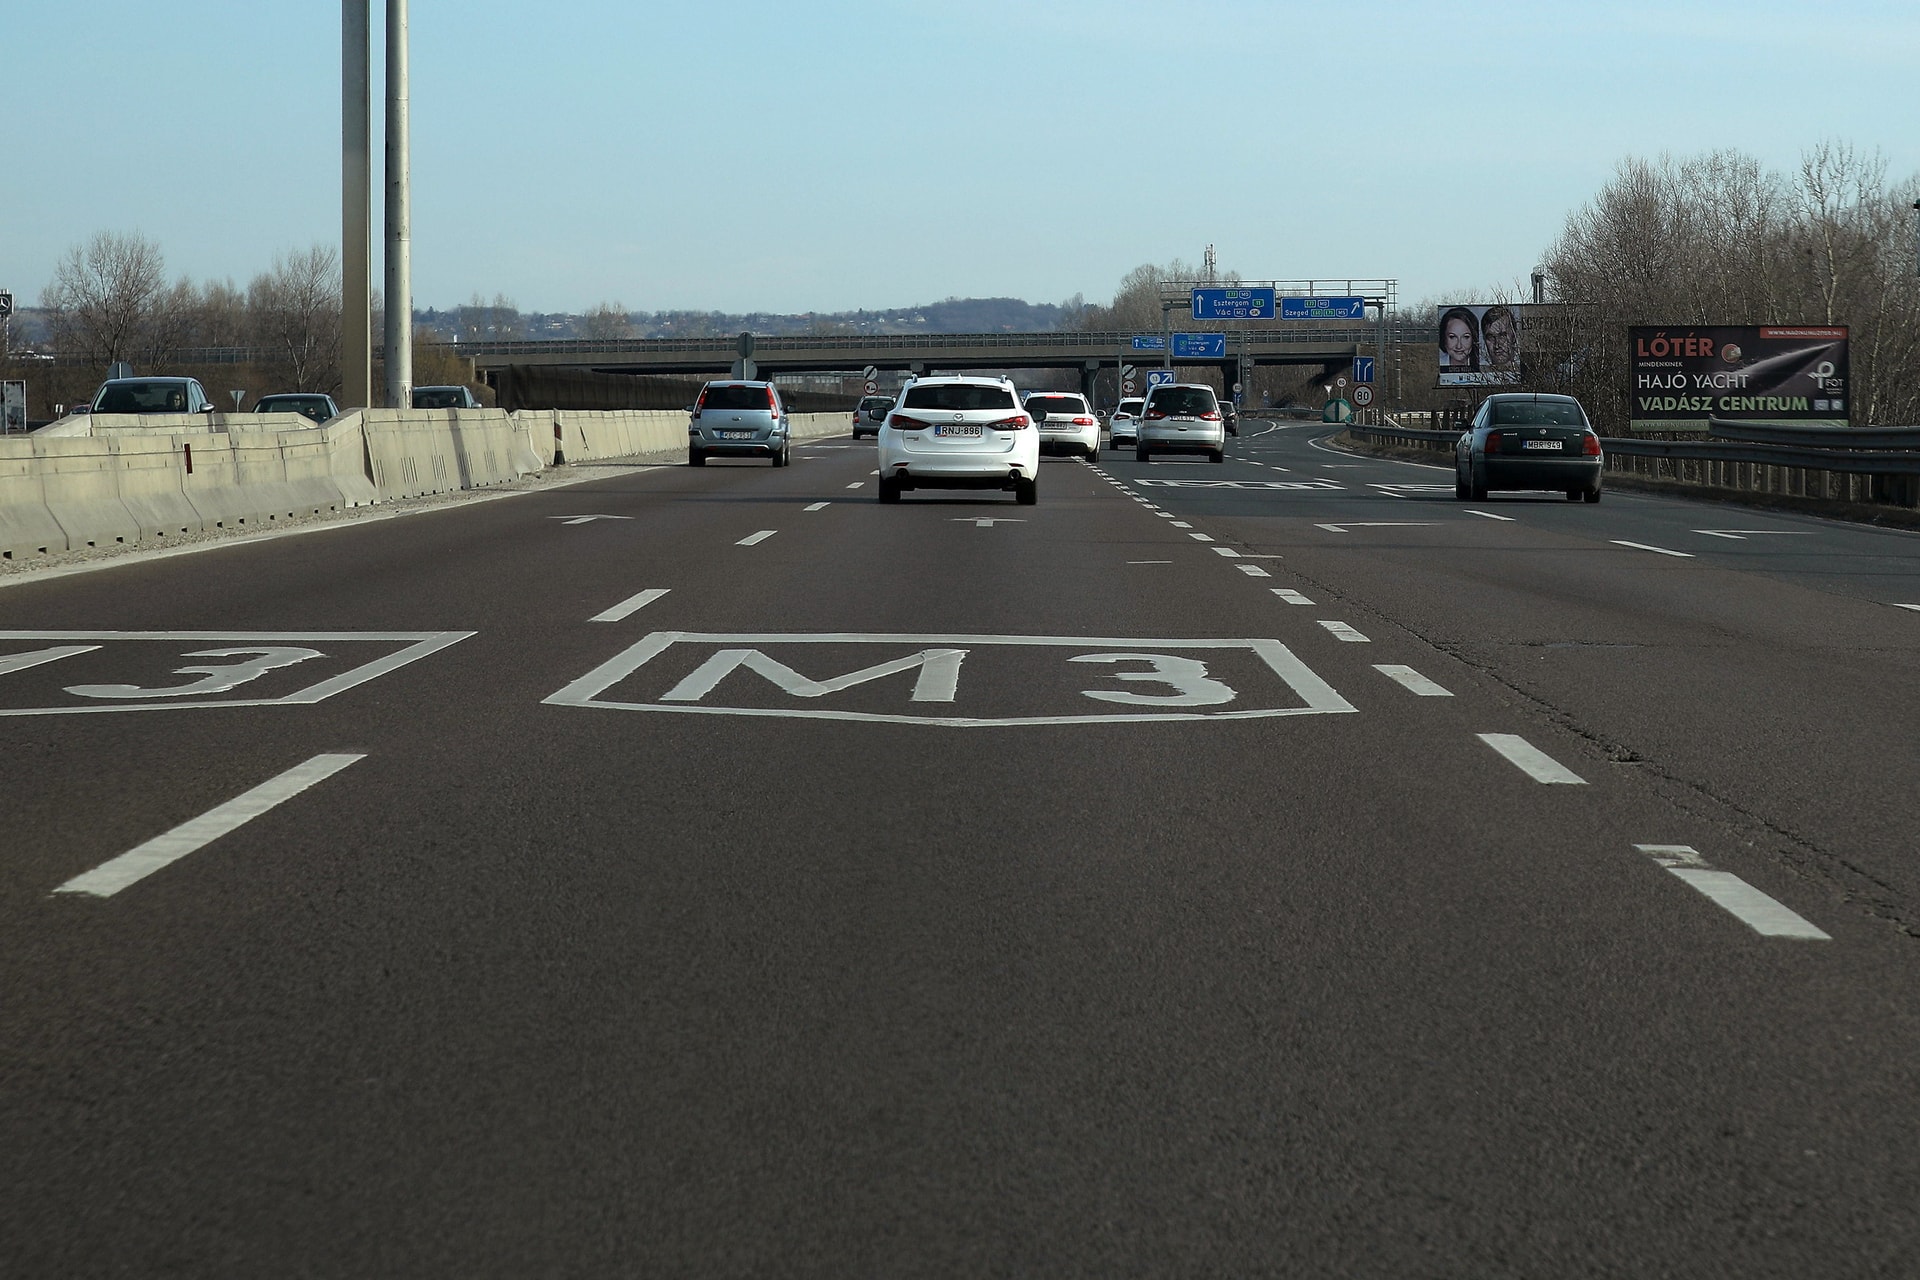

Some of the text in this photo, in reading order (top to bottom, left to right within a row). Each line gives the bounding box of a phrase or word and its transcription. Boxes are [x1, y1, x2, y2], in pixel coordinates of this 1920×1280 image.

[1213, 299, 1250, 307] Esztergom
[1215, 308, 1231, 316] Vác
[1284, 309, 1309, 317] Szeged
[1637, 332, 1714, 357] LŐTÉR
[1638, 371, 1749, 389] HAJÓ YACHT
[1356, 391, 1370, 401] 80
[1638, 392, 1809, 411] VADÁSZ CENTRUM
[941, 426, 980, 435] RNJ-896
